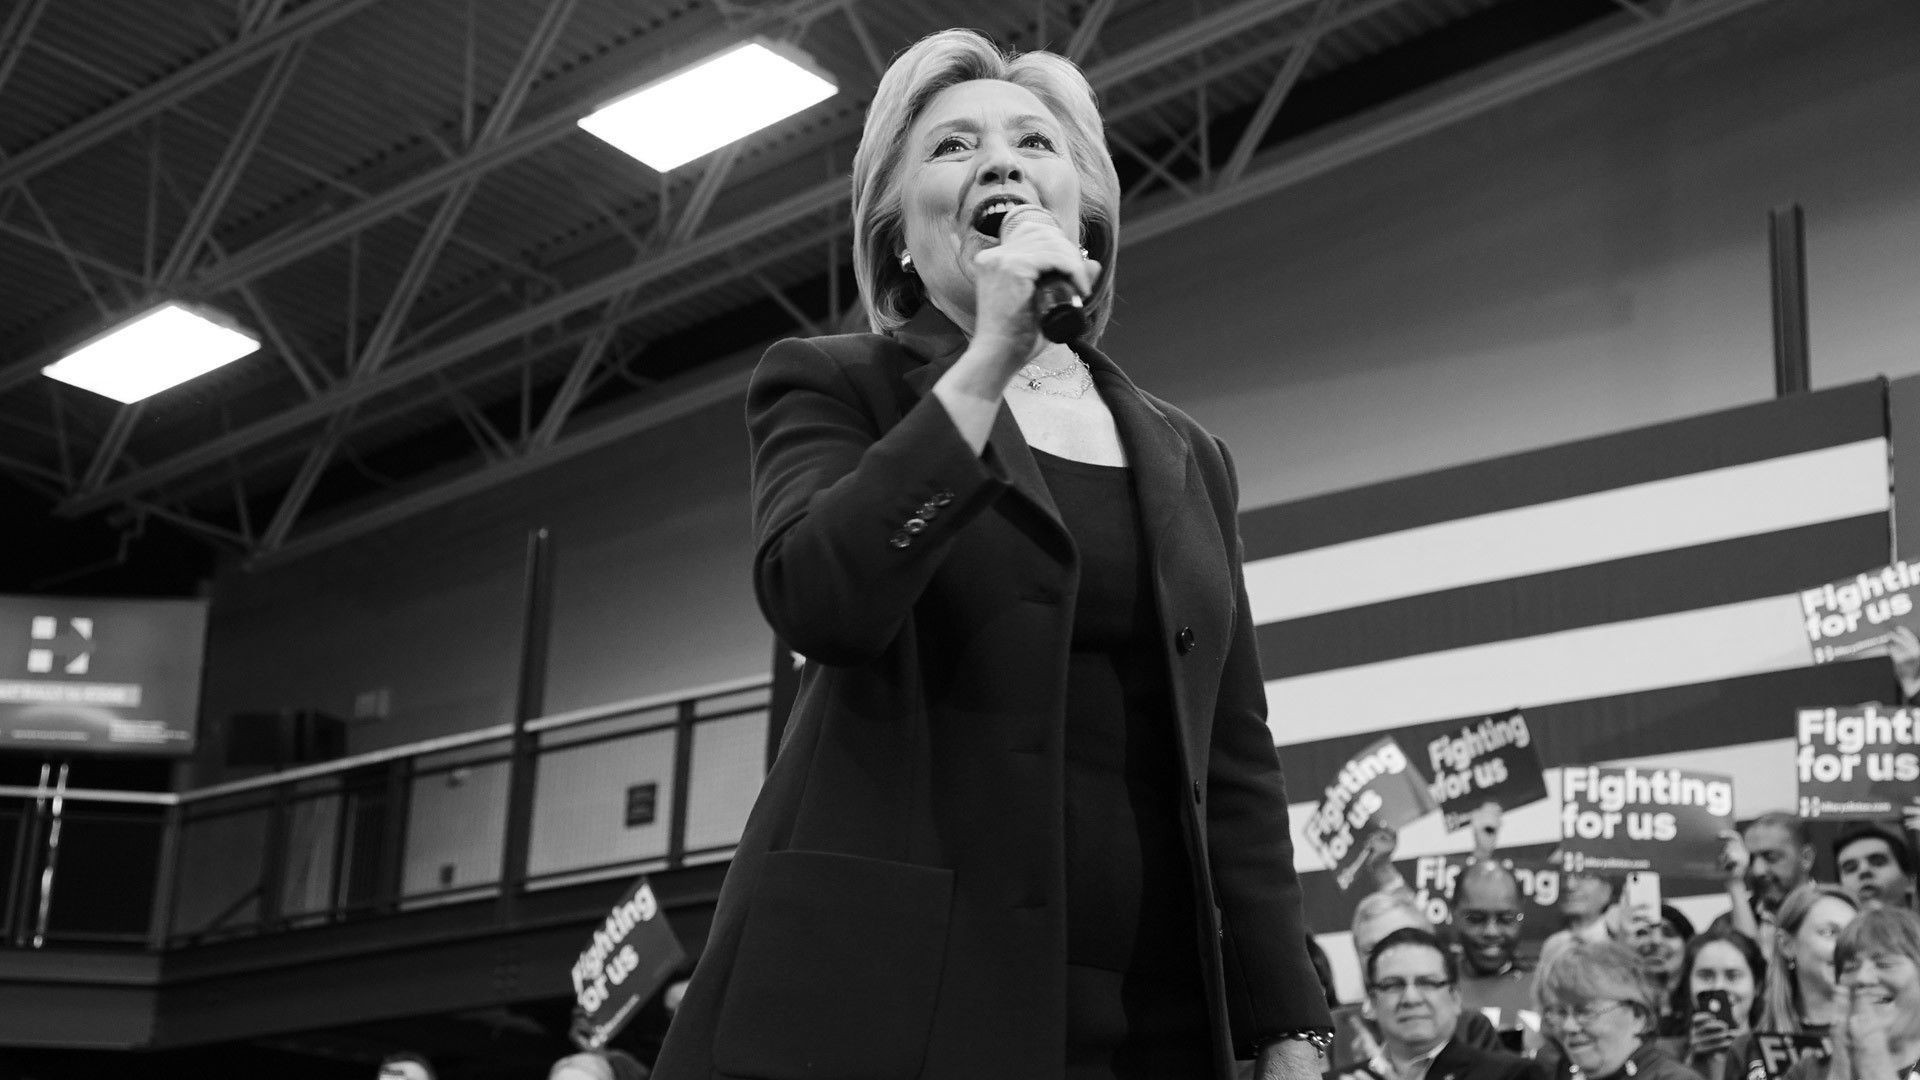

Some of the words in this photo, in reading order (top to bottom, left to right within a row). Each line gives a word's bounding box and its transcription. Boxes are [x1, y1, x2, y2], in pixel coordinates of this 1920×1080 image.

[1807, 610, 1862, 641] for
[1865, 593, 1912, 624] us
[1427, 713, 1530, 774] Fighting
[1798, 745, 1861, 782] for
[1867, 753, 1920, 782] us
[1307, 742, 1407, 848] Fighting
[1430, 769, 1473, 803] for
[1474, 757, 1508, 789] us
[1563, 766, 1733, 817] Fighting
[1347, 789, 1382, 829] us
[1563, 801, 1622, 840] for
[1626, 812, 1677, 841] us
[571, 883, 657, 996] Fighting
[605, 944, 639, 985] us
